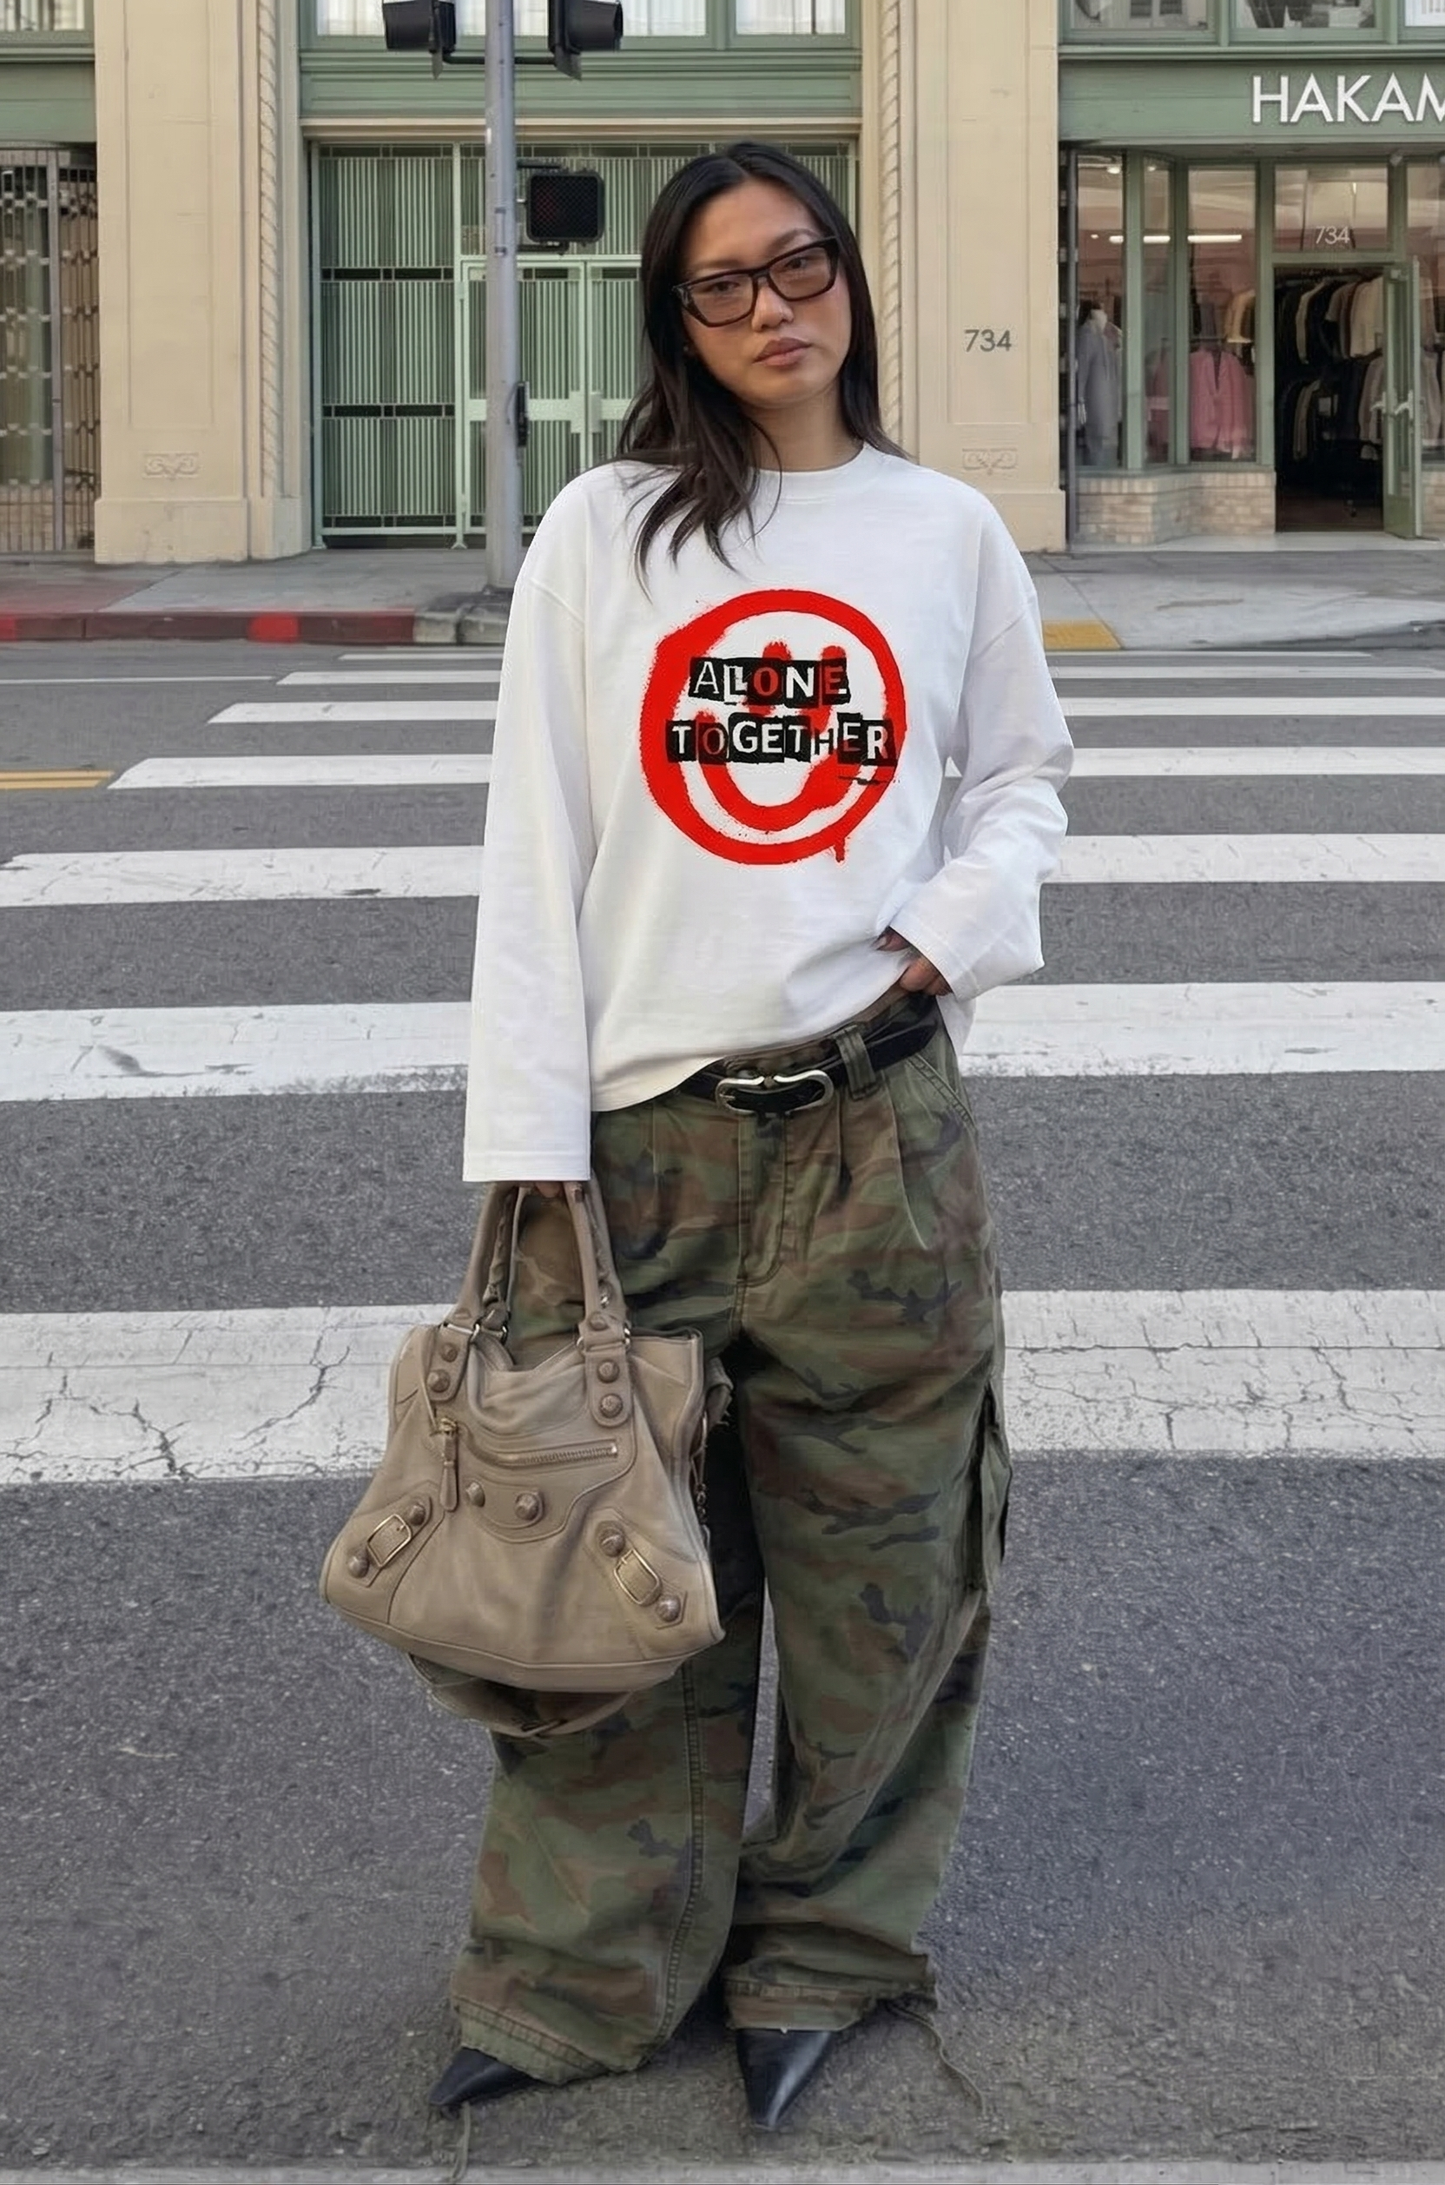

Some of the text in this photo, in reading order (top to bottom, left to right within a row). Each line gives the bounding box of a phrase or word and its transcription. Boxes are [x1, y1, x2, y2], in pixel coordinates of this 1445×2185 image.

[1315, 226, 1350, 244] 734
[964, 329, 1012, 352] 734
[692, 660, 848, 702] ALONE
[670, 719, 890, 760] TOGETHER
